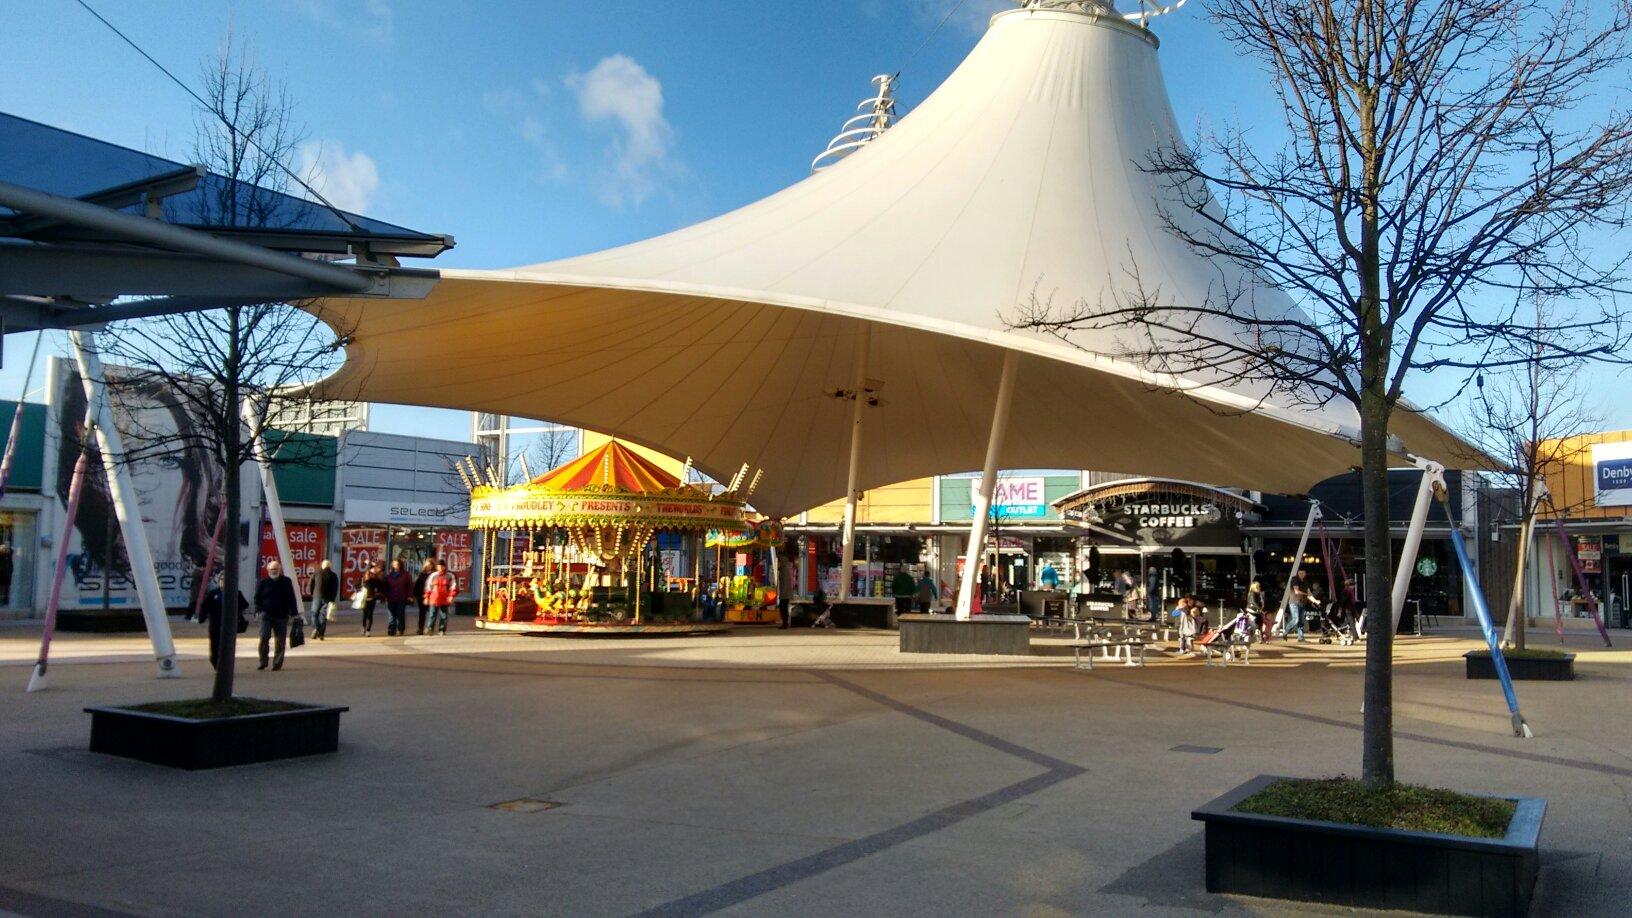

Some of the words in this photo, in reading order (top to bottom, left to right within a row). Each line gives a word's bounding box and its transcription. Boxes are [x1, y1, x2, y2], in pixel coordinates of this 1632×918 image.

[581, 501, 631, 512] PRESENTS
[1124, 504, 1209, 515] STARBUCKS
[1140, 516, 1193, 527] COFFEE
[290, 528, 317, 543] sale
[349, 531, 381, 545] SALE
[440, 534, 468, 547] SALE
[295, 563, 315, 577] ale
